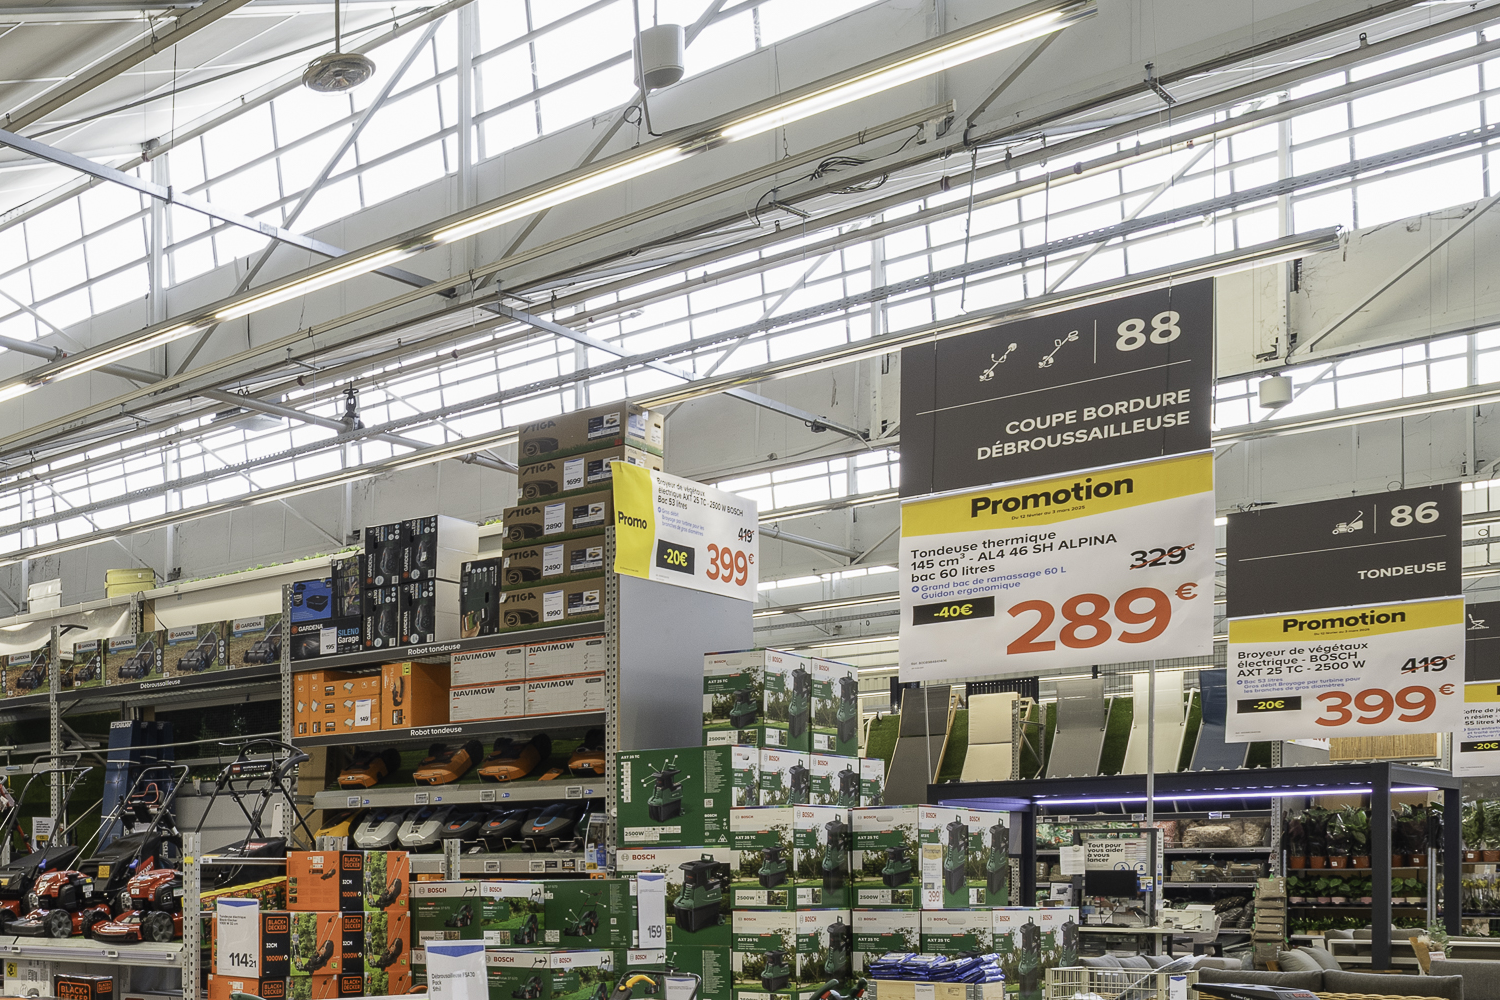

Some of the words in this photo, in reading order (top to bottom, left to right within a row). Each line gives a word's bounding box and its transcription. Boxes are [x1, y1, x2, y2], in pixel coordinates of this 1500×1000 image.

[1115, 311, 1182, 353] 88
[1005, 407, 1077, 435] COUPE
[1082, 389, 1191, 423] BORDURE
[977, 411, 1190, 461] DÉBROUSSAILLEUSE
[522, 462, 556, 476] STIGA
[971, 478, 1133, 518] Promotion
[618, 511, 647, 529] Promo
[1390, 501, 1439, 527] 86
[911, 542, 977, 559] Tondeuse
[982, 532, 1056, 549] thermique
[911, 559, 935, 571] 145
[977, 550, 1005, 562] AL4
[1010, 546, 1028, 557] 46
[1032, 543, 1053, 554] SH
[1058, 533, 1117, 551] ALPINA
[664, 549, 688, 567] -20€
[911, 570, 935, 583] bac
[940, 568, 957, 579] 60
[962, 563, 995, 576] litres
[921, 581, 950, 592] Grand
[953, 578, 969, 588] bac
[973, 577, 984, 585] de
[986, 569, 1041, 583] ramassage
[1044, 567, 1058, 575] 60
[1357, 560, 1447, 581] TONDEUSE
[921, 589, 954, 600] Guidon
[957, 581, 1020, 595] ergonomique
[934, 604, 973, 618] -40€
[298, 624, 323, 632] GARDENA
[1283, 610, 1405, 632] Promotion
[338, 628, 359, 636] SILENO
[338, 635, 359, 644] Garage
[407, 647, 428, 656] Robot
[429, 643, 461, 654] tondeuse
[453, 651, 496, 662] NAVIMOW
[529, 642, 575, 654] NAVIMOW
[1238, 649, 1285, 660] Broyeur
[1289, 647, 1305, 655] de
[1308, 642, 1368, 654] végétaux
[1237, 657, 1298, 669] électrique
[1310, 652, 1357, 663] BOSCH
[1237, 668, 1263, 677] AXT
[1267, 667, 1282, 675] 25
[1286, 665, 1303, 673] TC
[1315, 662, 1348, 671] 2500
[1353, 660, 1366, 668] W
[140, 678, 181, 689] Débroussailleuse
[1253, 700, 1284, 710] -20€
